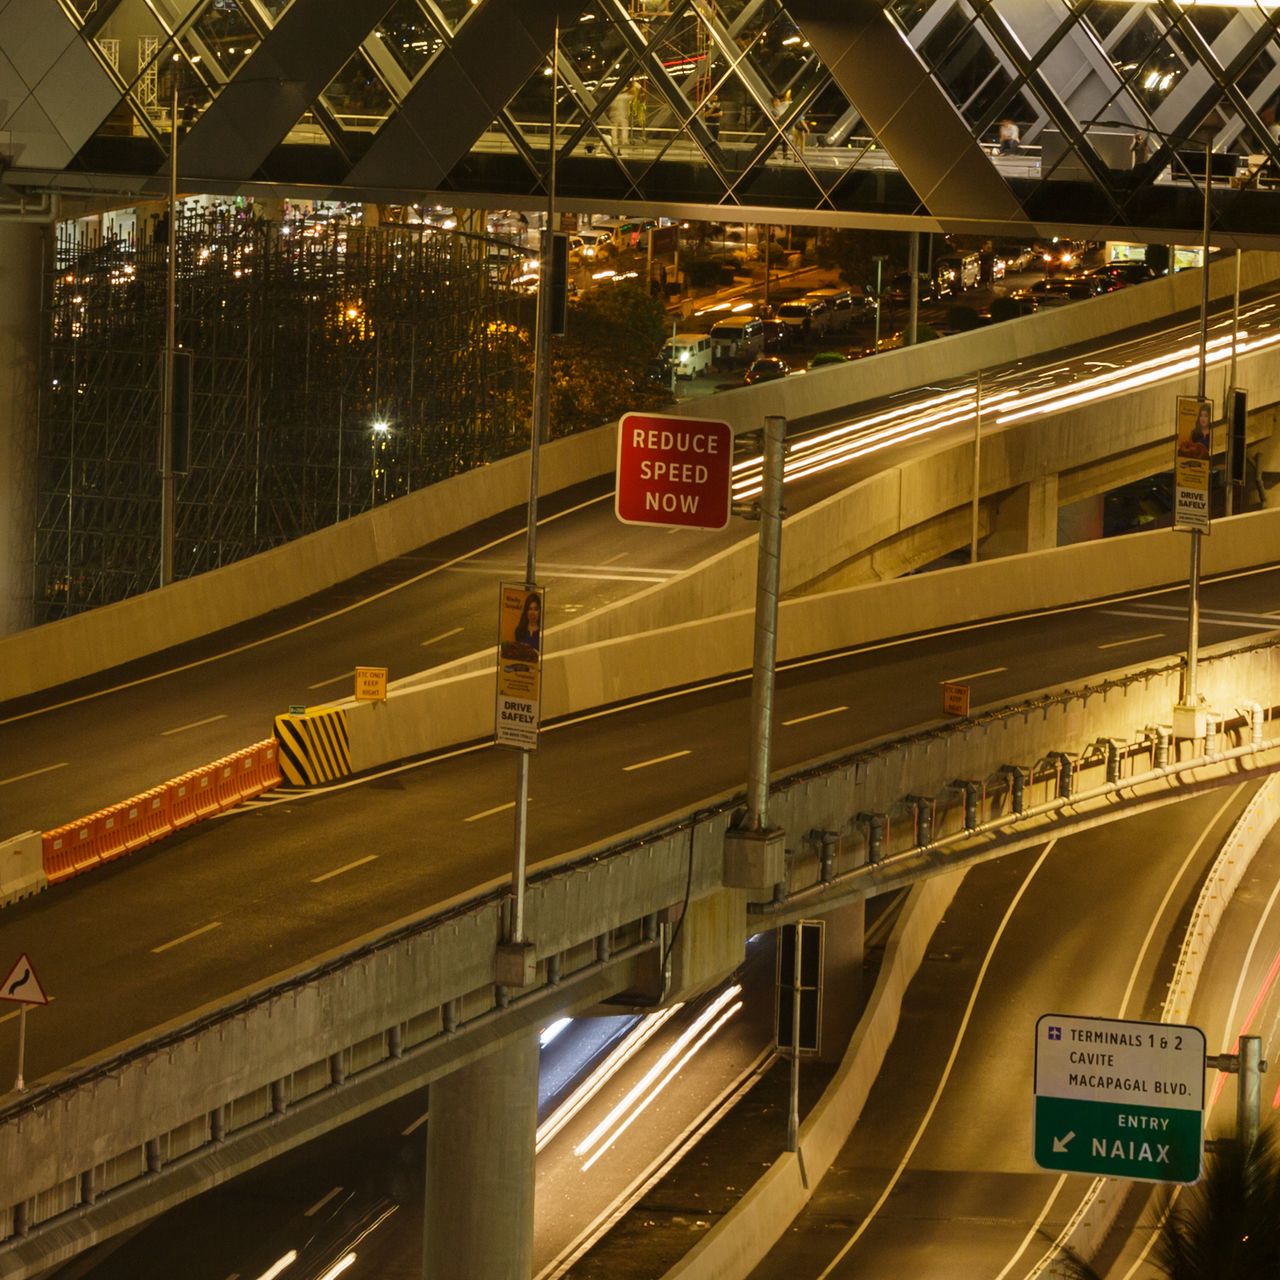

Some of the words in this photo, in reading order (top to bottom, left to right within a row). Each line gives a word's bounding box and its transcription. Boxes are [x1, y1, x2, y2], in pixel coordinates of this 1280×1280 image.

[632, 428, 718, 454] REDUCE
[640, 460, 708, 484] SPEED
[646, 492, 700, 514] NOW
[1178, 499, 1206, 510] SAFELY
[1180, 491, 1204, 502] DRIVE
[504, 701, 532, 714] DRIVE
[502, 711, 535, 724] SAFELY
[1070, 1029, 1142, 1047] TERMINALS
[1149, 1034, 1154, 1048] 1
[1160, 1037, 1168, 1050] &
[1175, 1036, 1183, 1051] 2
[1070, 1052, 1114, 1067] CAVITE
[1069, 1073, 1148, 1092] MACAPAGAL
[1154, 1082, 1192, 1097] BLVD.
[1118, 1114, 1170, 1131] ENTRY
[1092, 1138, 1171, 1164] NAIAX
